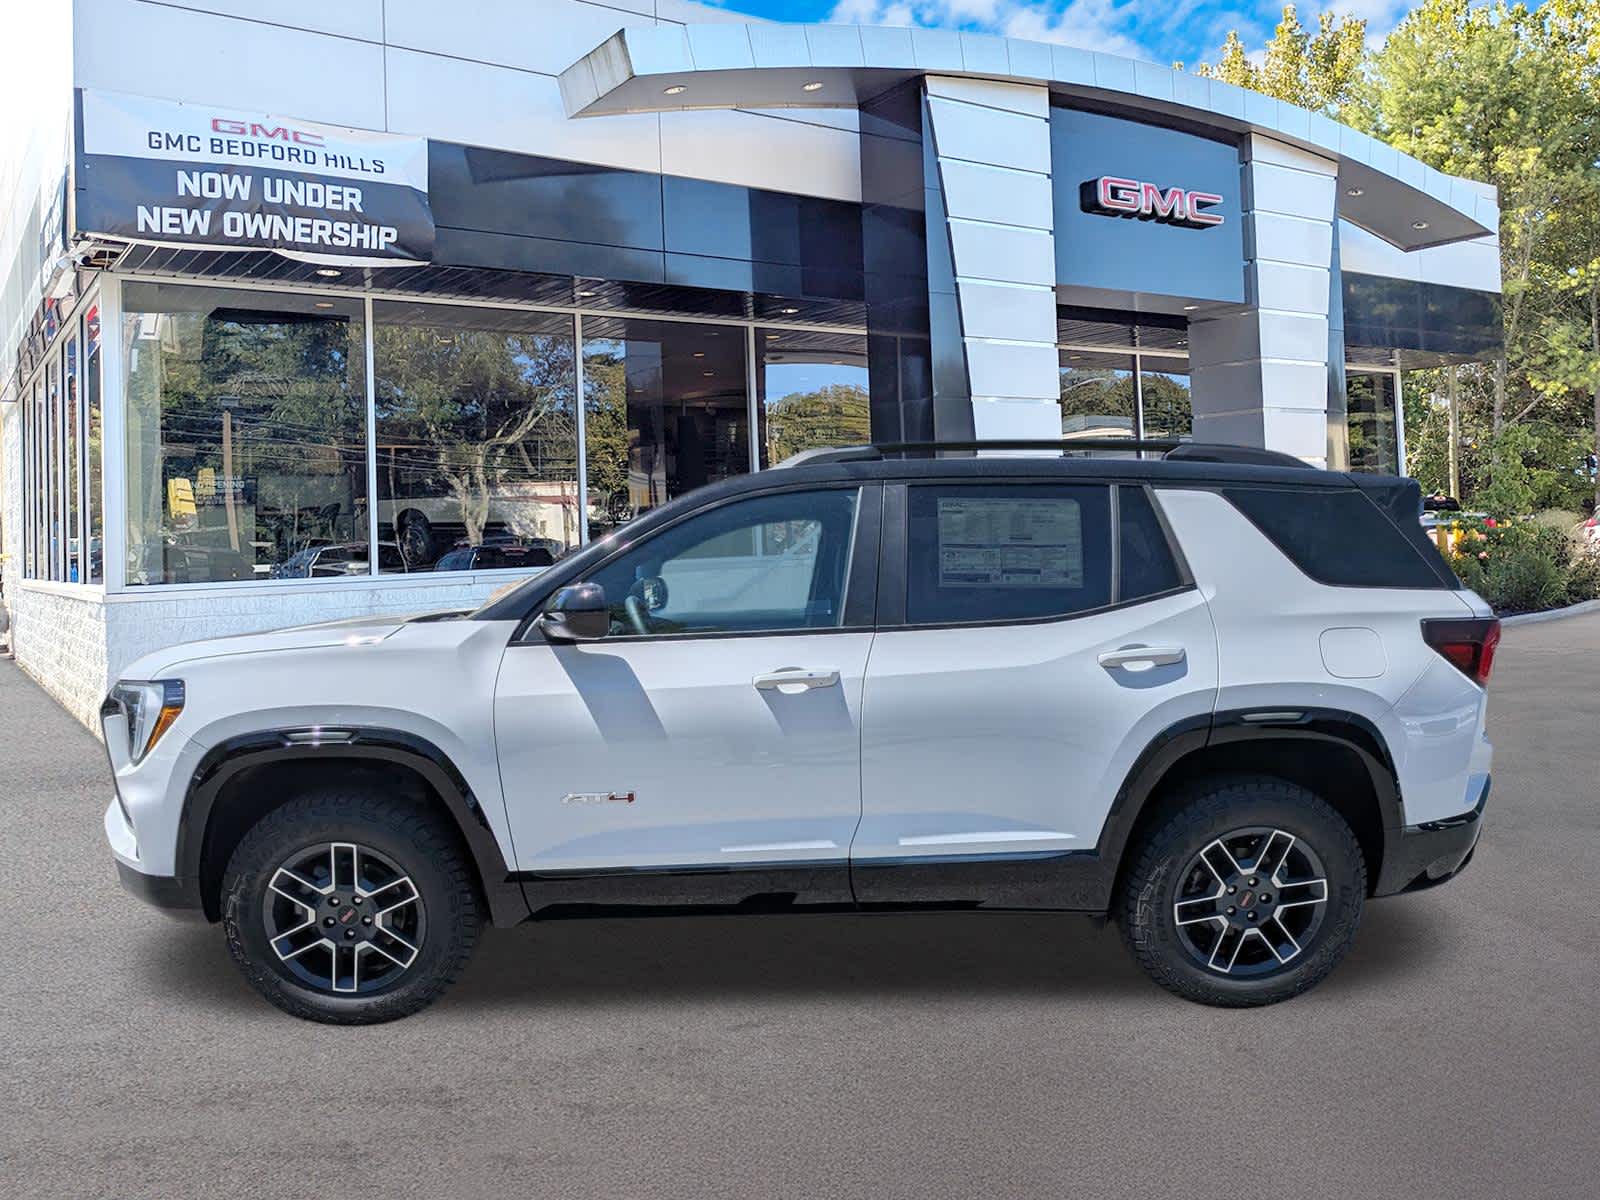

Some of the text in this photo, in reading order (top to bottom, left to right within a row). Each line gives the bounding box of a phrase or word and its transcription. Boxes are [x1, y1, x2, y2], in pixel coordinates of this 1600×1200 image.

[148, 131, 386, 174] GMC BEDFORD HILLS
[211, 117, 326, 148] GMC
[176, 170, 364, 213] NOW UNDER
[1098, 175, 1226, 225] GMC
[136, 205, 399, 250] NEW OWNERSHIP
